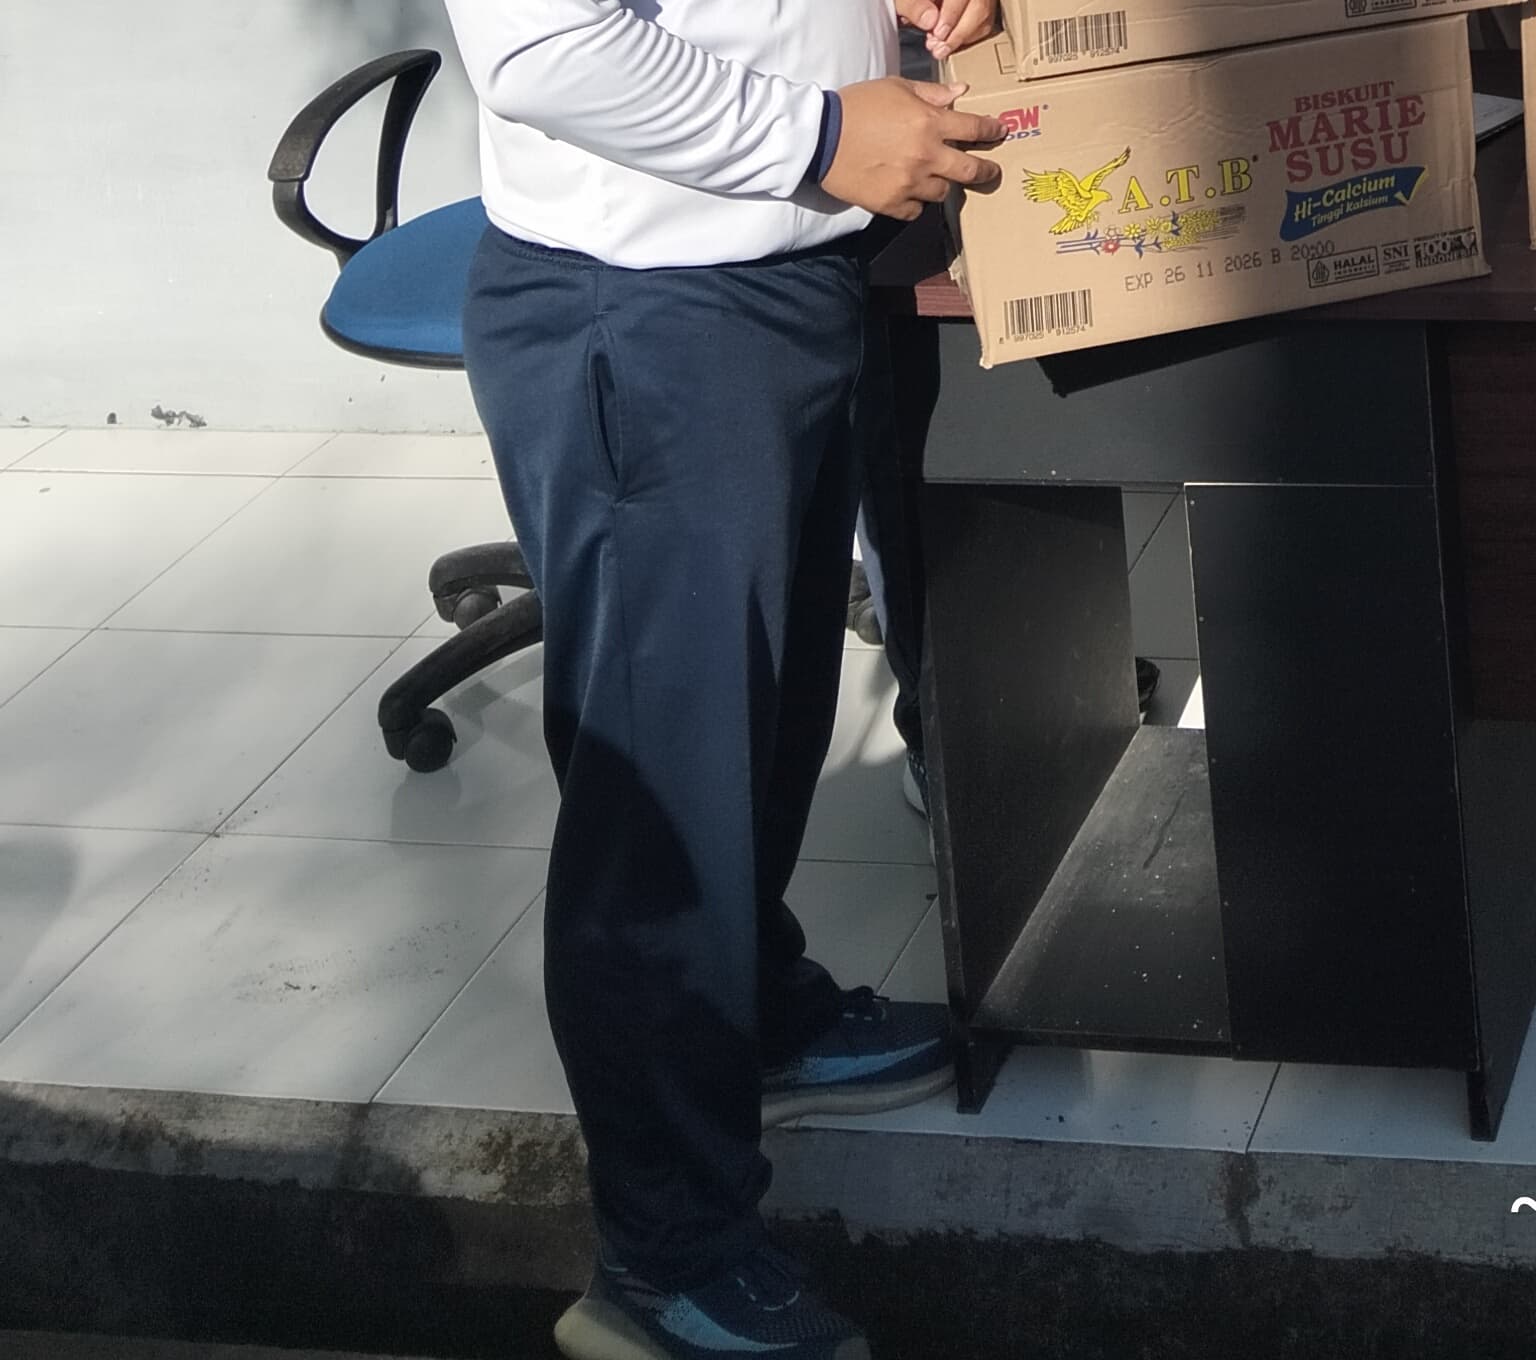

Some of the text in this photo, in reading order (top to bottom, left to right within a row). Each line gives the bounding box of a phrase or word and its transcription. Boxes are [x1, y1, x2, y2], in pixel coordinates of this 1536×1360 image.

[1294, 80, 1394, 113] BISKUIT
[1265, 94, 1426, 153] MARIE
[1285, 130, 1409, 184] SUSU
[1293, 174, 1396, 223] Hi-Calcium
[1311, 206, 1344, 228] Tinggi
[1125, 272, 1153, 292] EXP
[1164, 265, 1186, 285] 26
[1197, 261, 1214, 279] 11
[1224, 252, 1263, 273] 2026
[1290, 239, 1336, 262] 20:00
[1333, 253, 1375, 271] HALAL
[1383, 245, 1409, 261] SNI
